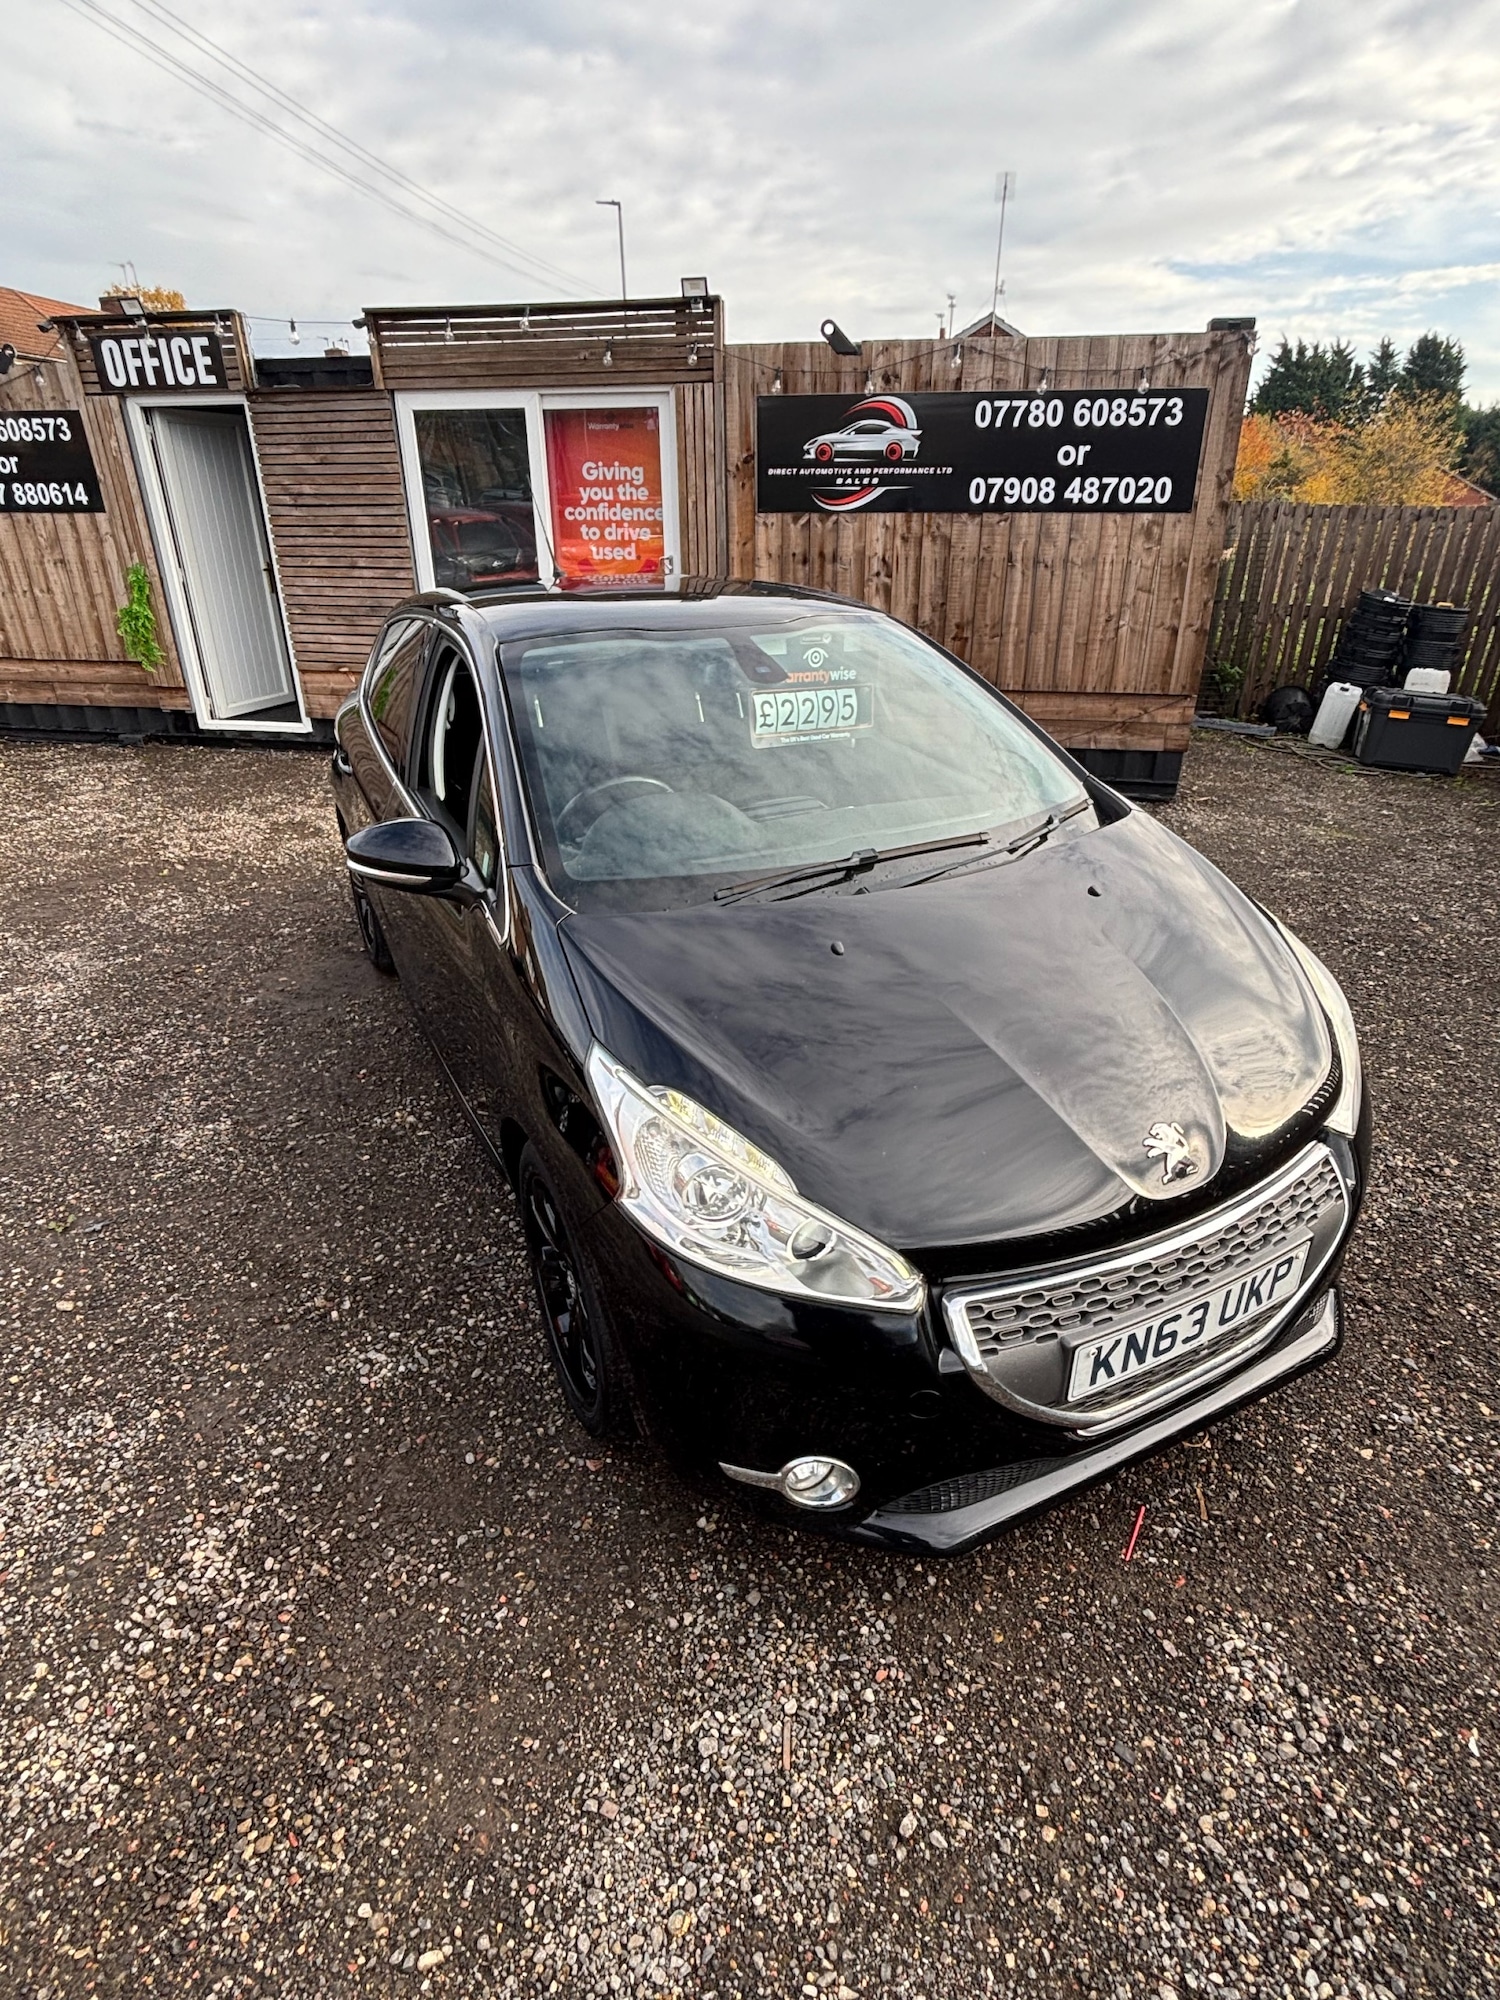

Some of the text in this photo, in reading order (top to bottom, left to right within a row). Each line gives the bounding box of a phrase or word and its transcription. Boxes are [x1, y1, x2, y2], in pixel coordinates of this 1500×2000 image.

[101, 337, 217, 387] OFFICE
[975, 397, 1183, 428] 07780 608573
[0, 456, 18, 474] or
[1057, 444, 1091, 466] or
[582, 461, 643, 485] Giving
[836, 477, 879, 485] SALES
[854, 467, 871, 475] AND
[873, 467, 935, 475] PERFORMANCE
[12, 482, 89, 505] 880614
[579, 483, 649, 505] you the
[969, 477, 1172, 504] 07908 487020
[564, 502, 663, 521] confidence
[581, 522, 651, 540] to drive
[786, 666, 857, 684] arrantywise
[759, 695, 855, 728] £2295
[1089, 1256, 1294, 1387] KN63 UKP
